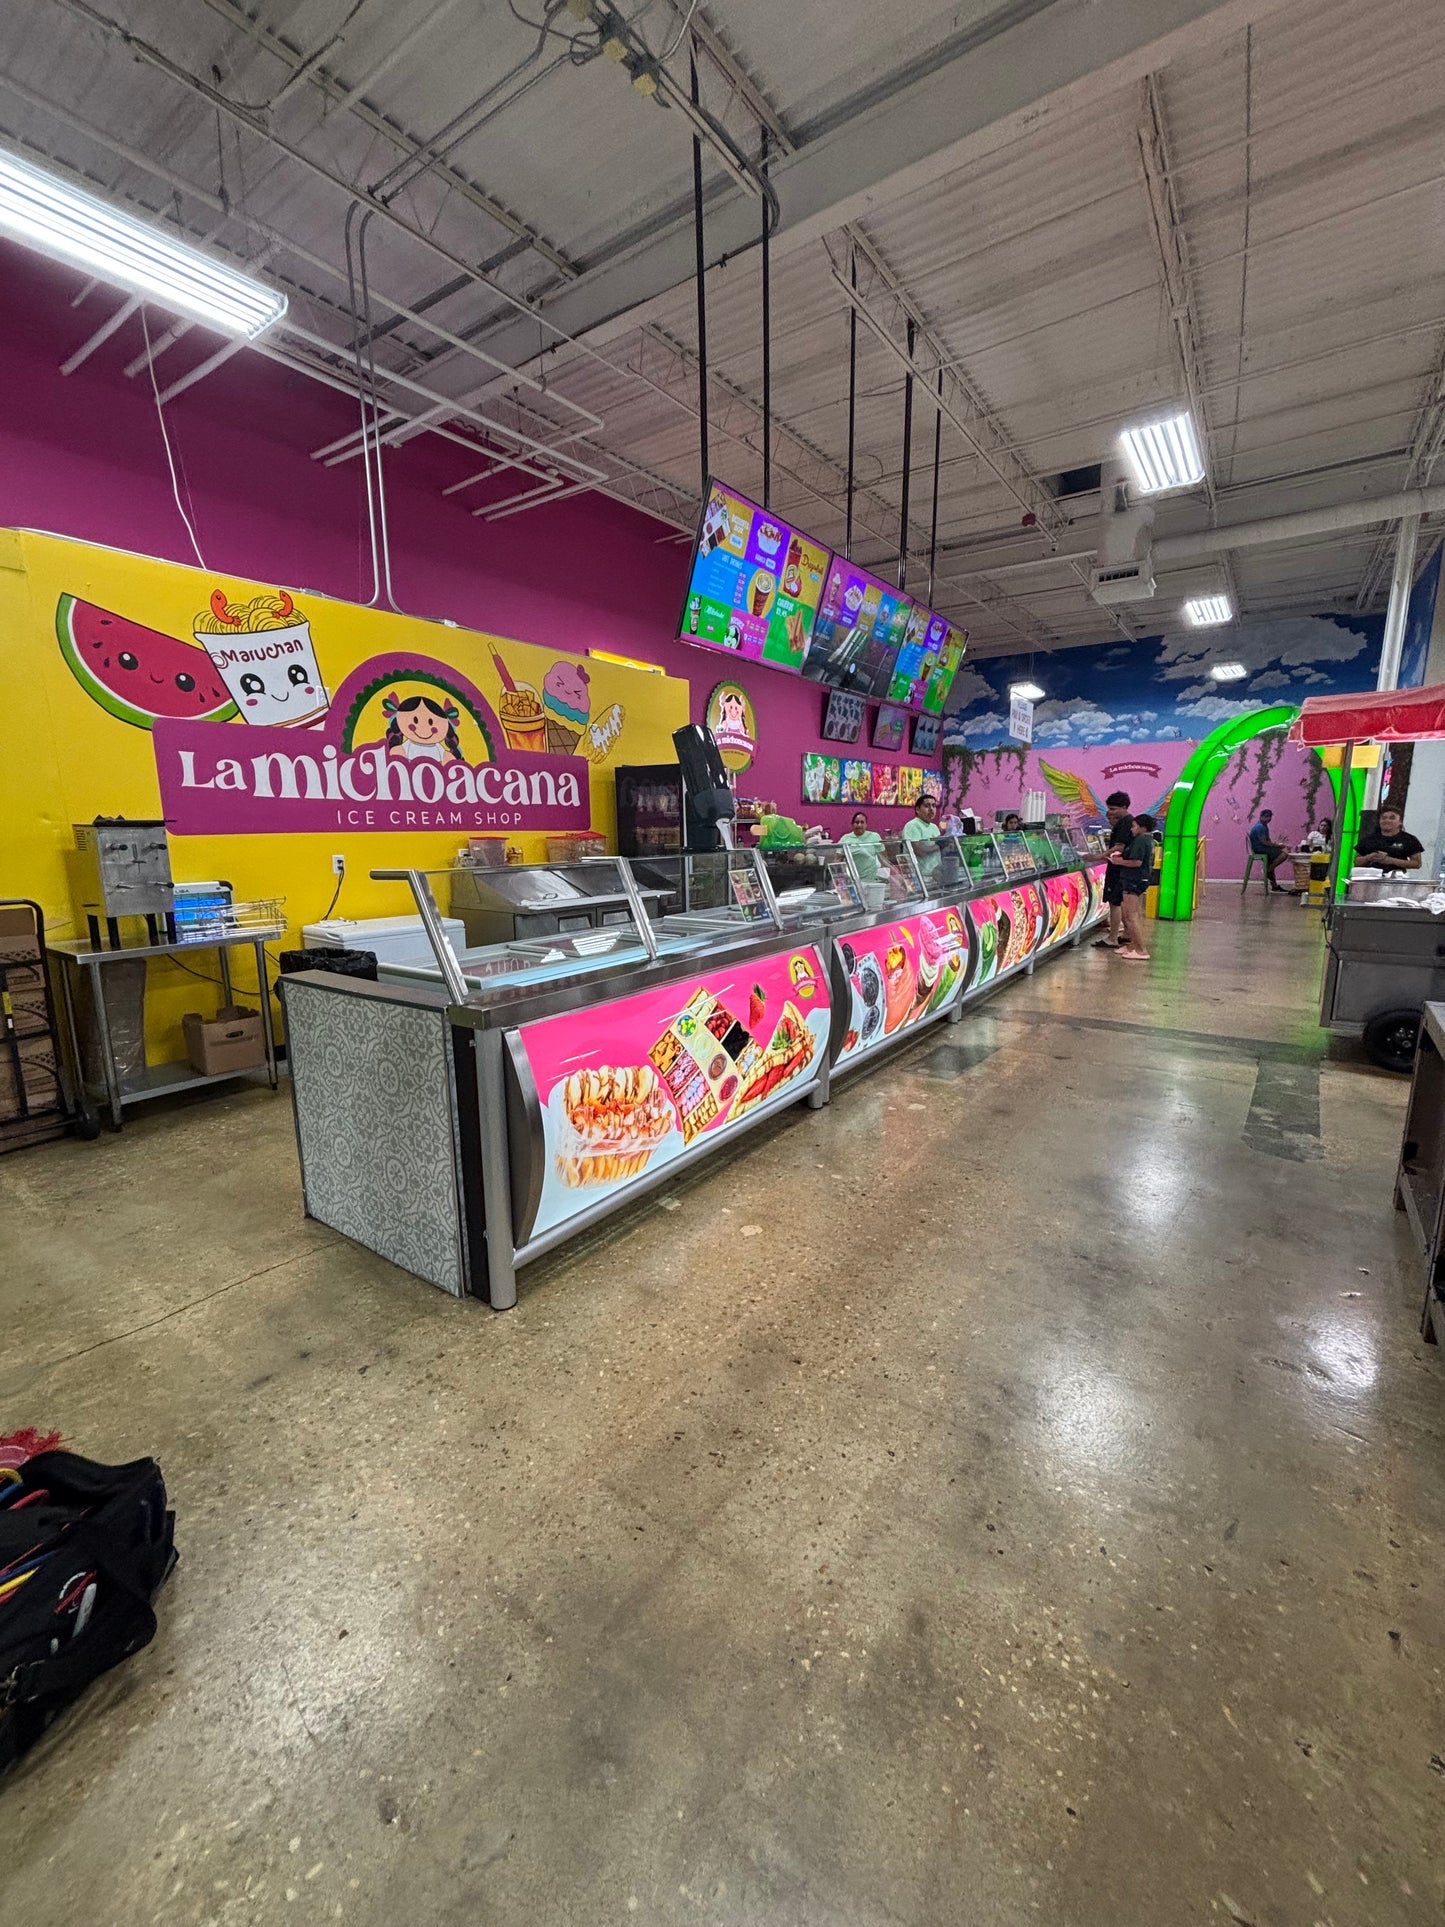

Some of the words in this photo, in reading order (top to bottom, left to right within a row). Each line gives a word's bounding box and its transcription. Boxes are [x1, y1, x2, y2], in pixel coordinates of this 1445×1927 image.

[220, 639, 304, 662] Maruchan
[178, 750, 248, 791] La
[250, 744, 581, 807] michoacana
[337, 810, 375, 825] ICE
[390, 810, 463, 825] CREAM
[475, 811, 522, 825] SHOP
